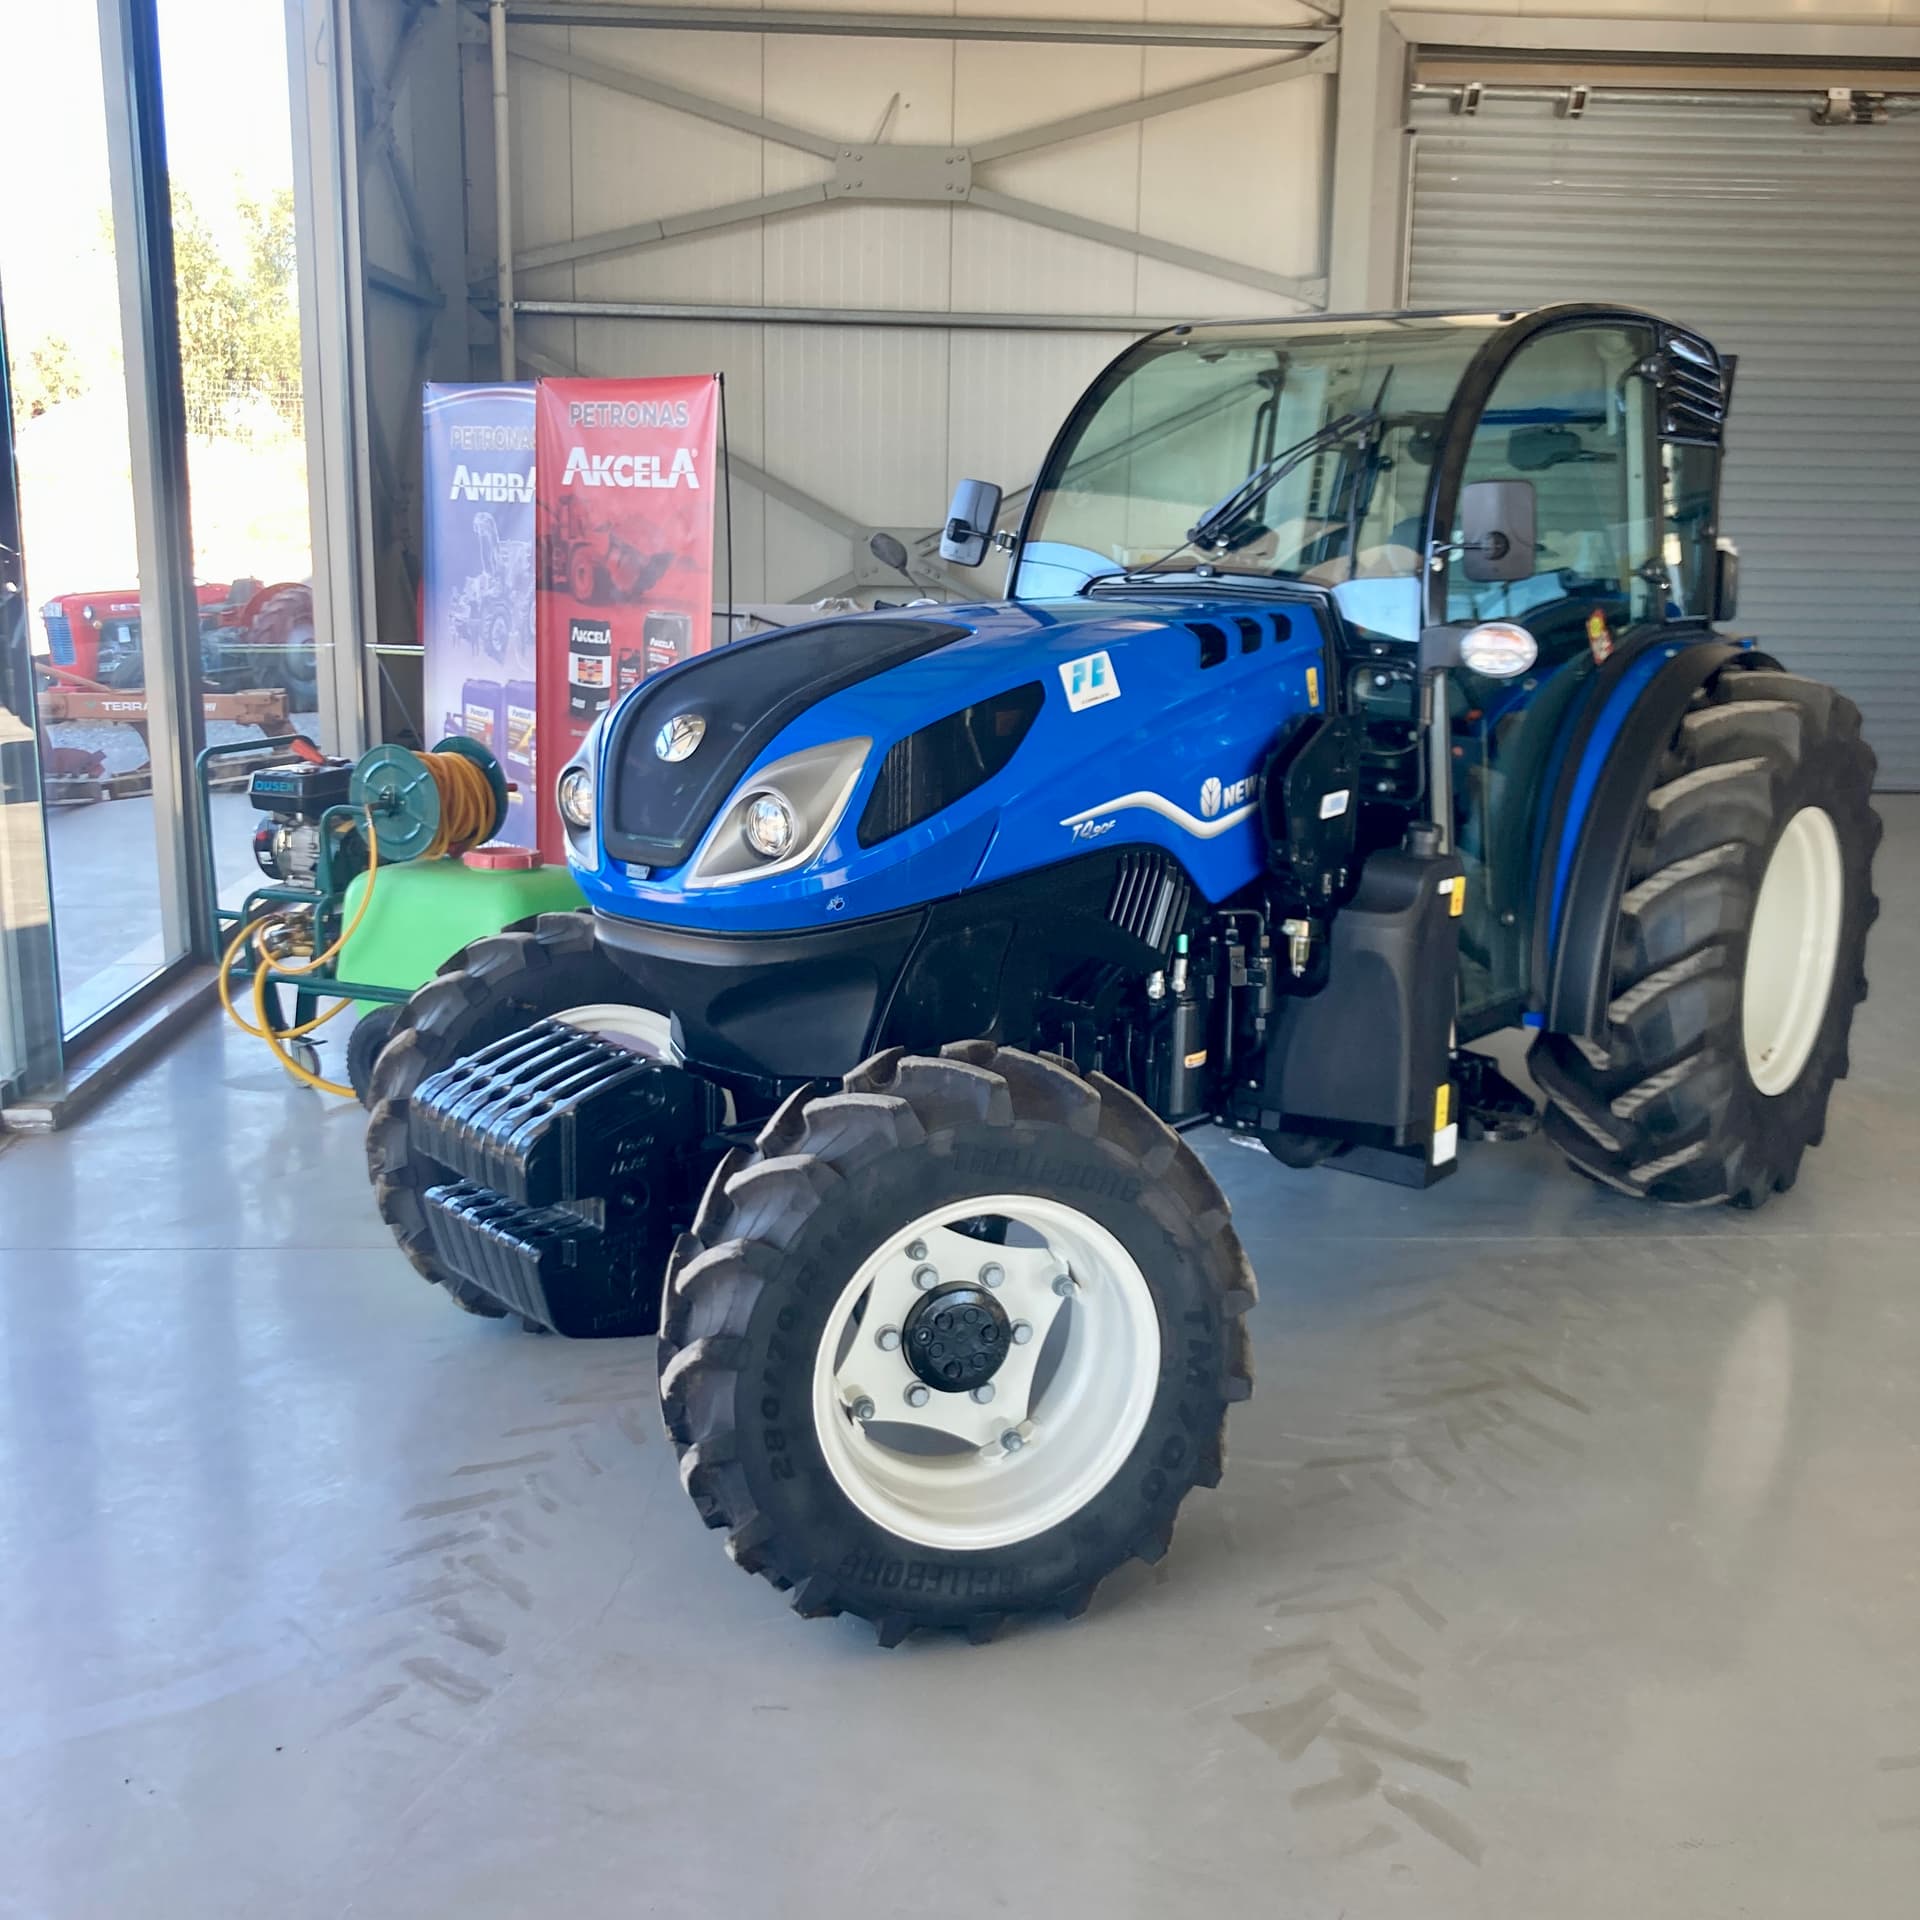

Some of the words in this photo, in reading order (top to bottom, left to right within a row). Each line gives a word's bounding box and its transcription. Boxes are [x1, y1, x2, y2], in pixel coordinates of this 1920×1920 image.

[568, 400, 690, 428] PETRONAS
[561, 447, 699, 489] AKCELA
[1222, 773, 1259, 810] NEW
[838, 1550, 1034, 1600] RELLEBORG
